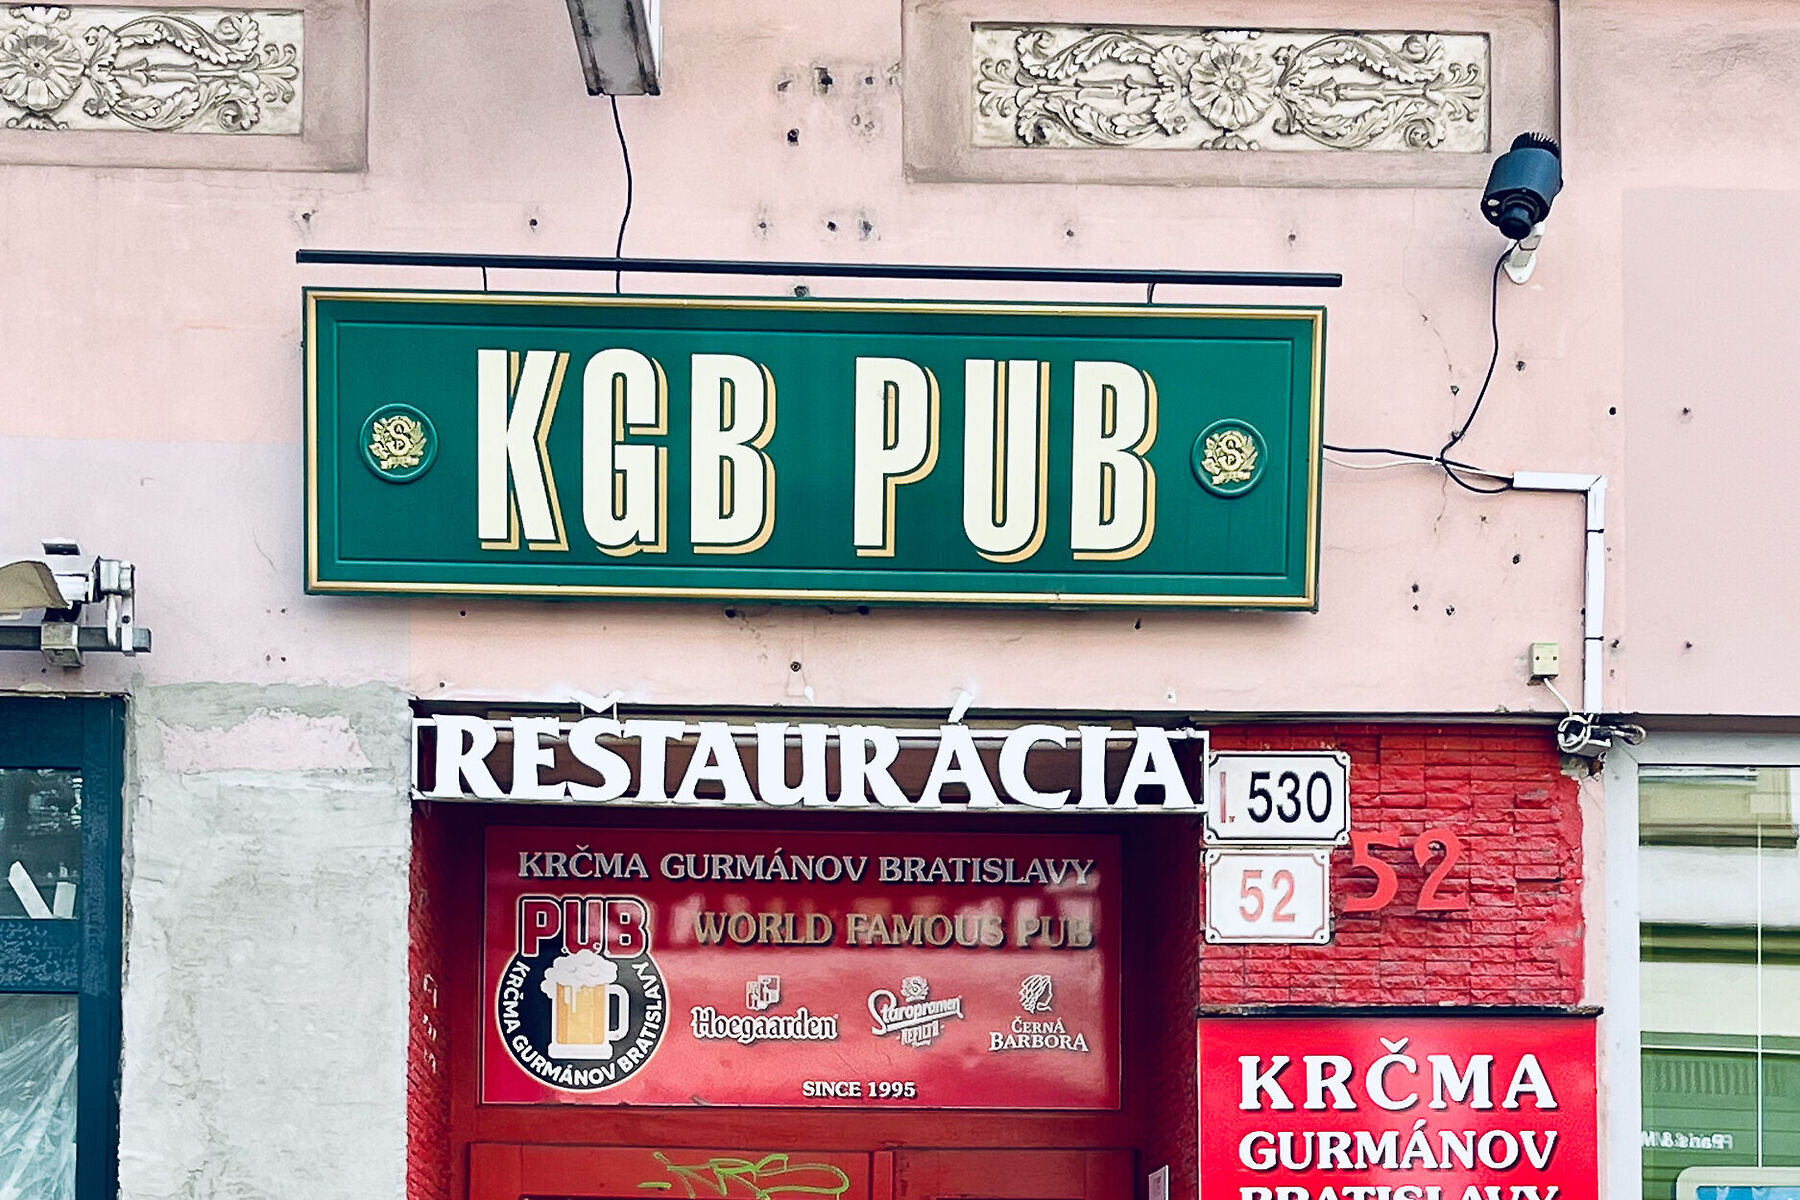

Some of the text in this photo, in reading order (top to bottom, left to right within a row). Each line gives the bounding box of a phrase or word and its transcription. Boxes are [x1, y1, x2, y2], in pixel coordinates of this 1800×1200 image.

[477, 346, 1158, 564] KGB PUB
[430, 690, 1199, 809] REŠTAURÁCIA
[1248, 771, 1332, 823] 530
[518, 844, 1095, 885] KRČMA GURMÁNOV BRATISLAVY
[1343, 829, 1470, 911] 52
[1240, 870, 1296, 922] 52
[518, 894, 650, 959] PUB
[695, 911, 1096, 948] WORLD FAMOUS PUB
[503, 960, 664, 1087] KRČMA GURMÁNOV BRATISLAVY
[690, 1006, 837, 1044] Hoegaarden
[867, 989, 963, 1036] Staropramen
[1011, 1016, 1065, 1034] ČERNÁ
[988, 1032, 1089, 1052] BARBORA
[803, 1081, 916, 1098] SINCE 1995
[1238, 1037, 1557, 1110] KRČMA
[1238, 1119, 1558, 1170] GURMÁNOV
